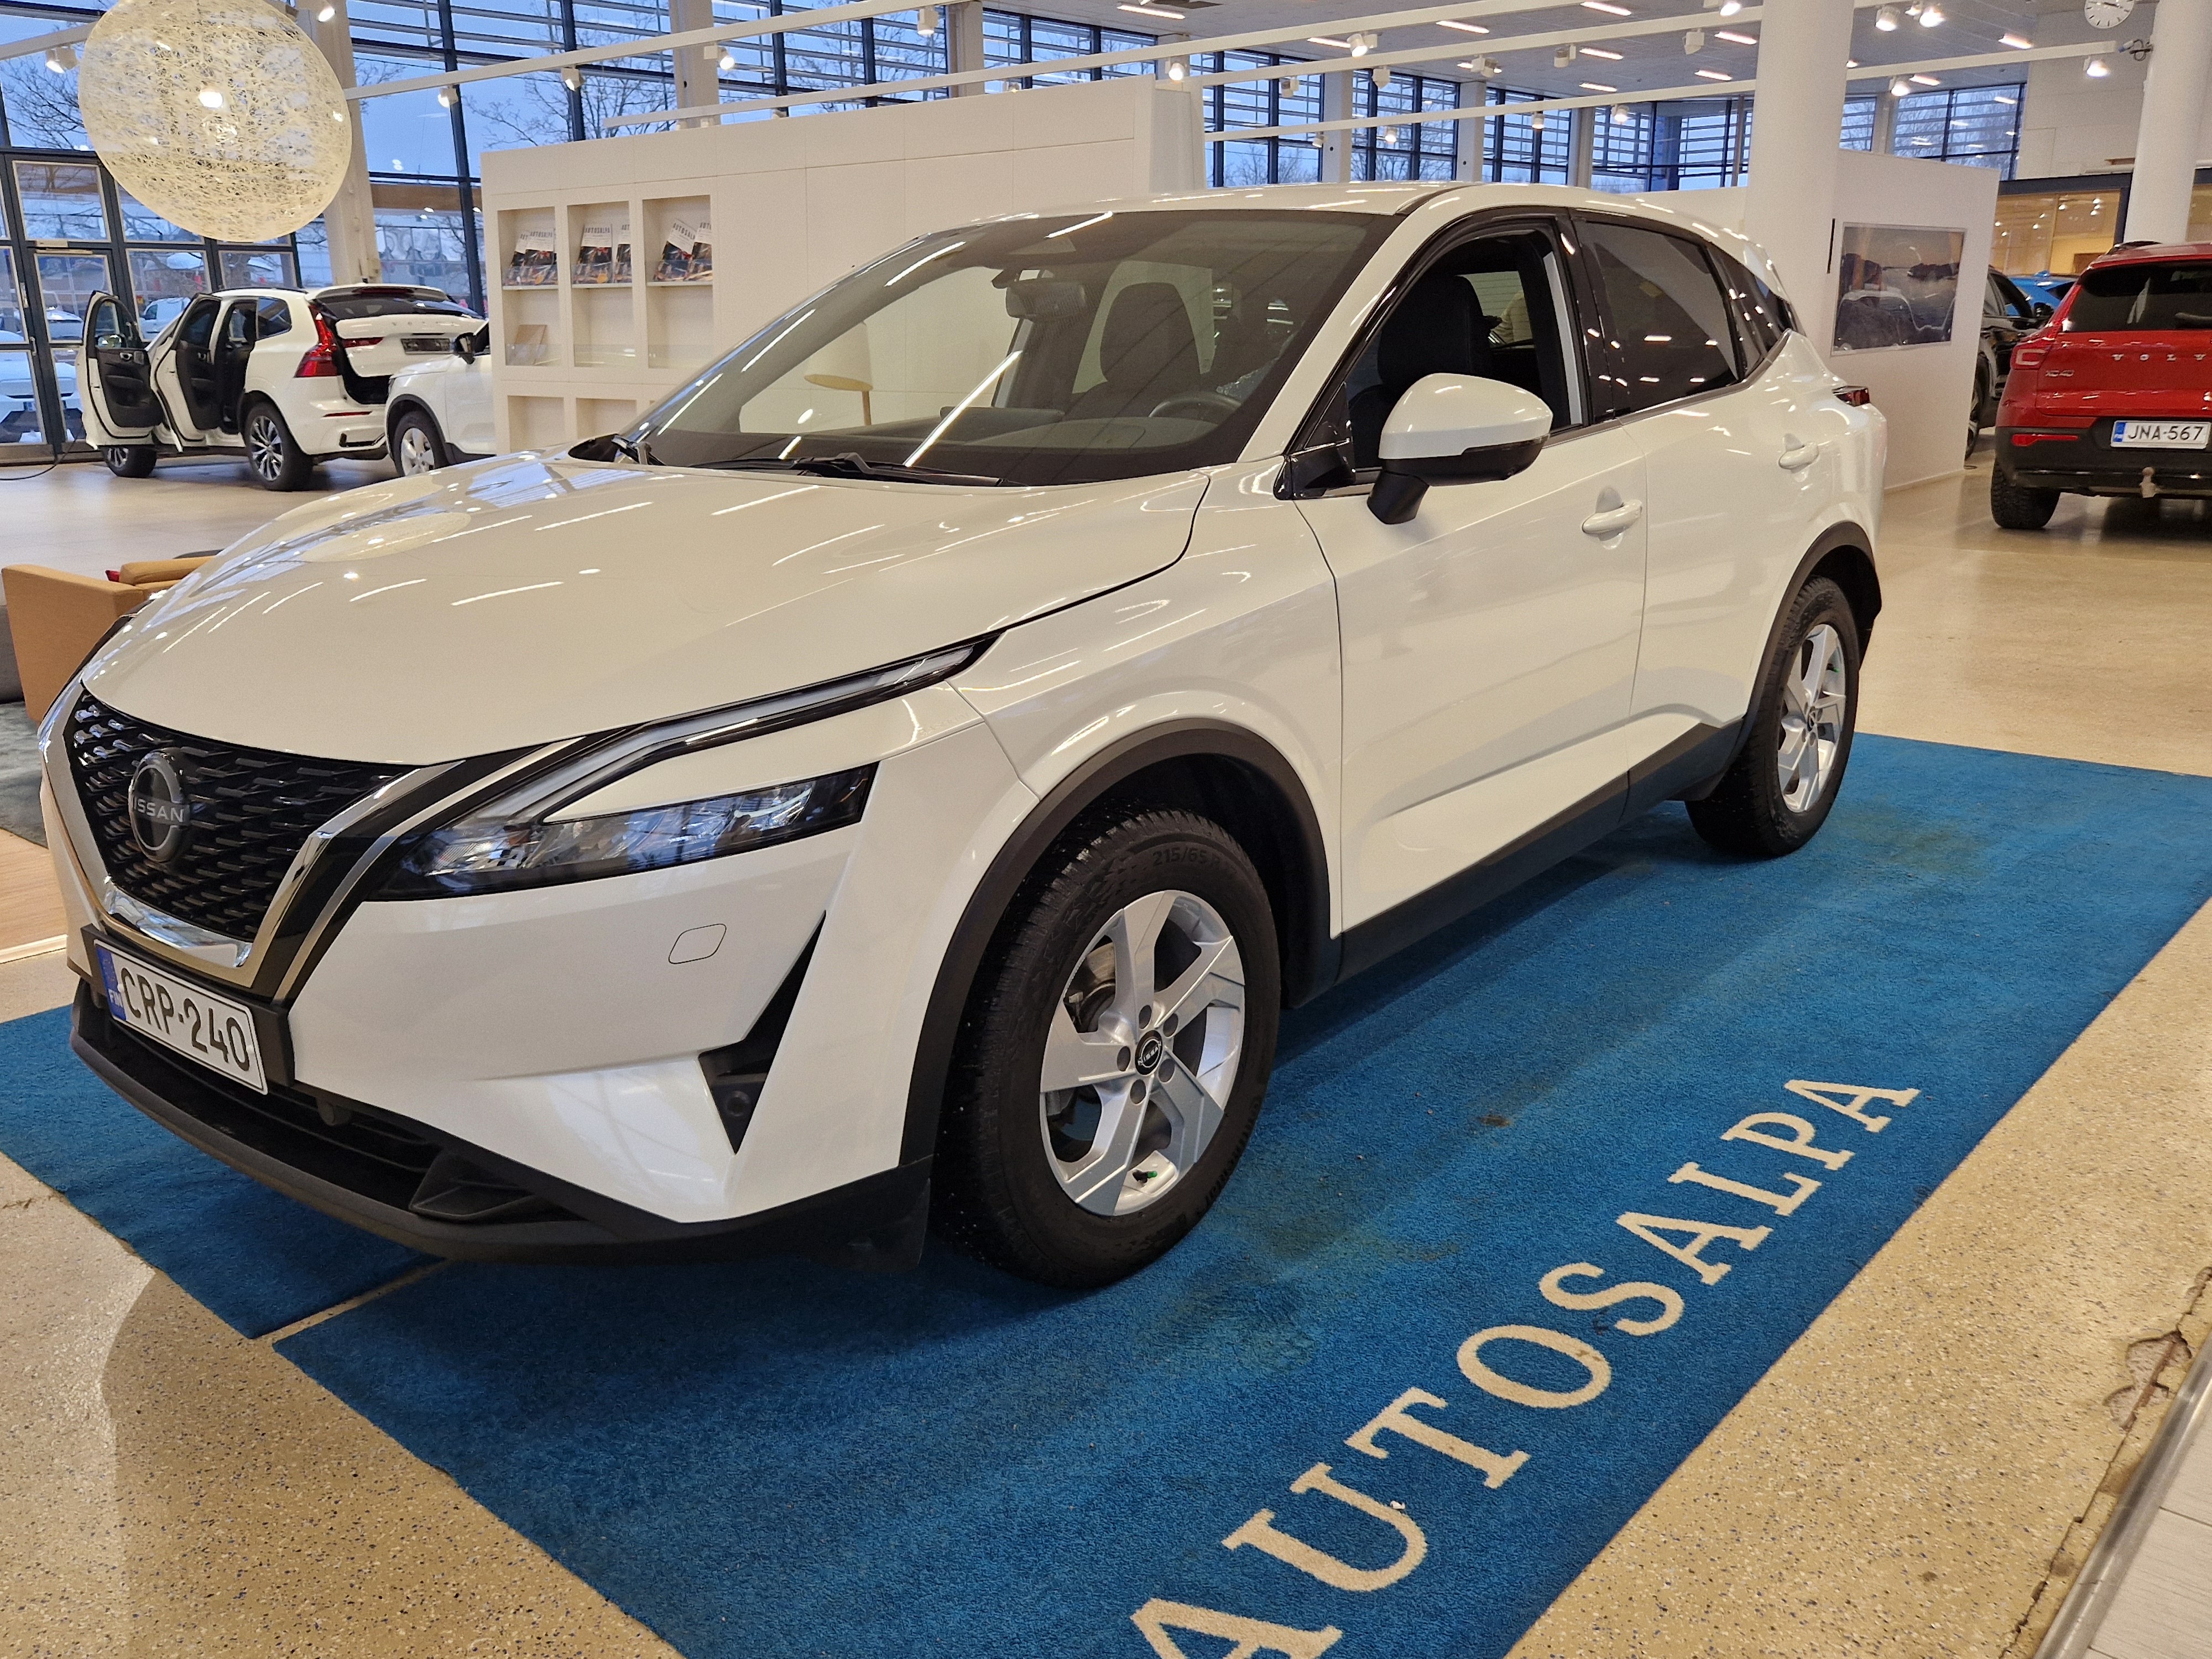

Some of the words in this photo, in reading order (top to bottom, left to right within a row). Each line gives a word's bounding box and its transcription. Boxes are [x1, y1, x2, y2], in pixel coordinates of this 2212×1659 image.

[672, 222, 696, 240] AUTOSALP
[2128, 425, 2204, 441] JNA-567
[133, 796, 185, 823] ISSAN
[1152, 847, 1207, 867] 215/65
[108, 989, 123, 1008] FIN
[121, 967, 250, 1072] CRP-240
[1137, 1040, 1162, 1066] NISSAN
[1131, 1079, 1920, 1659] AUTOSALPA
